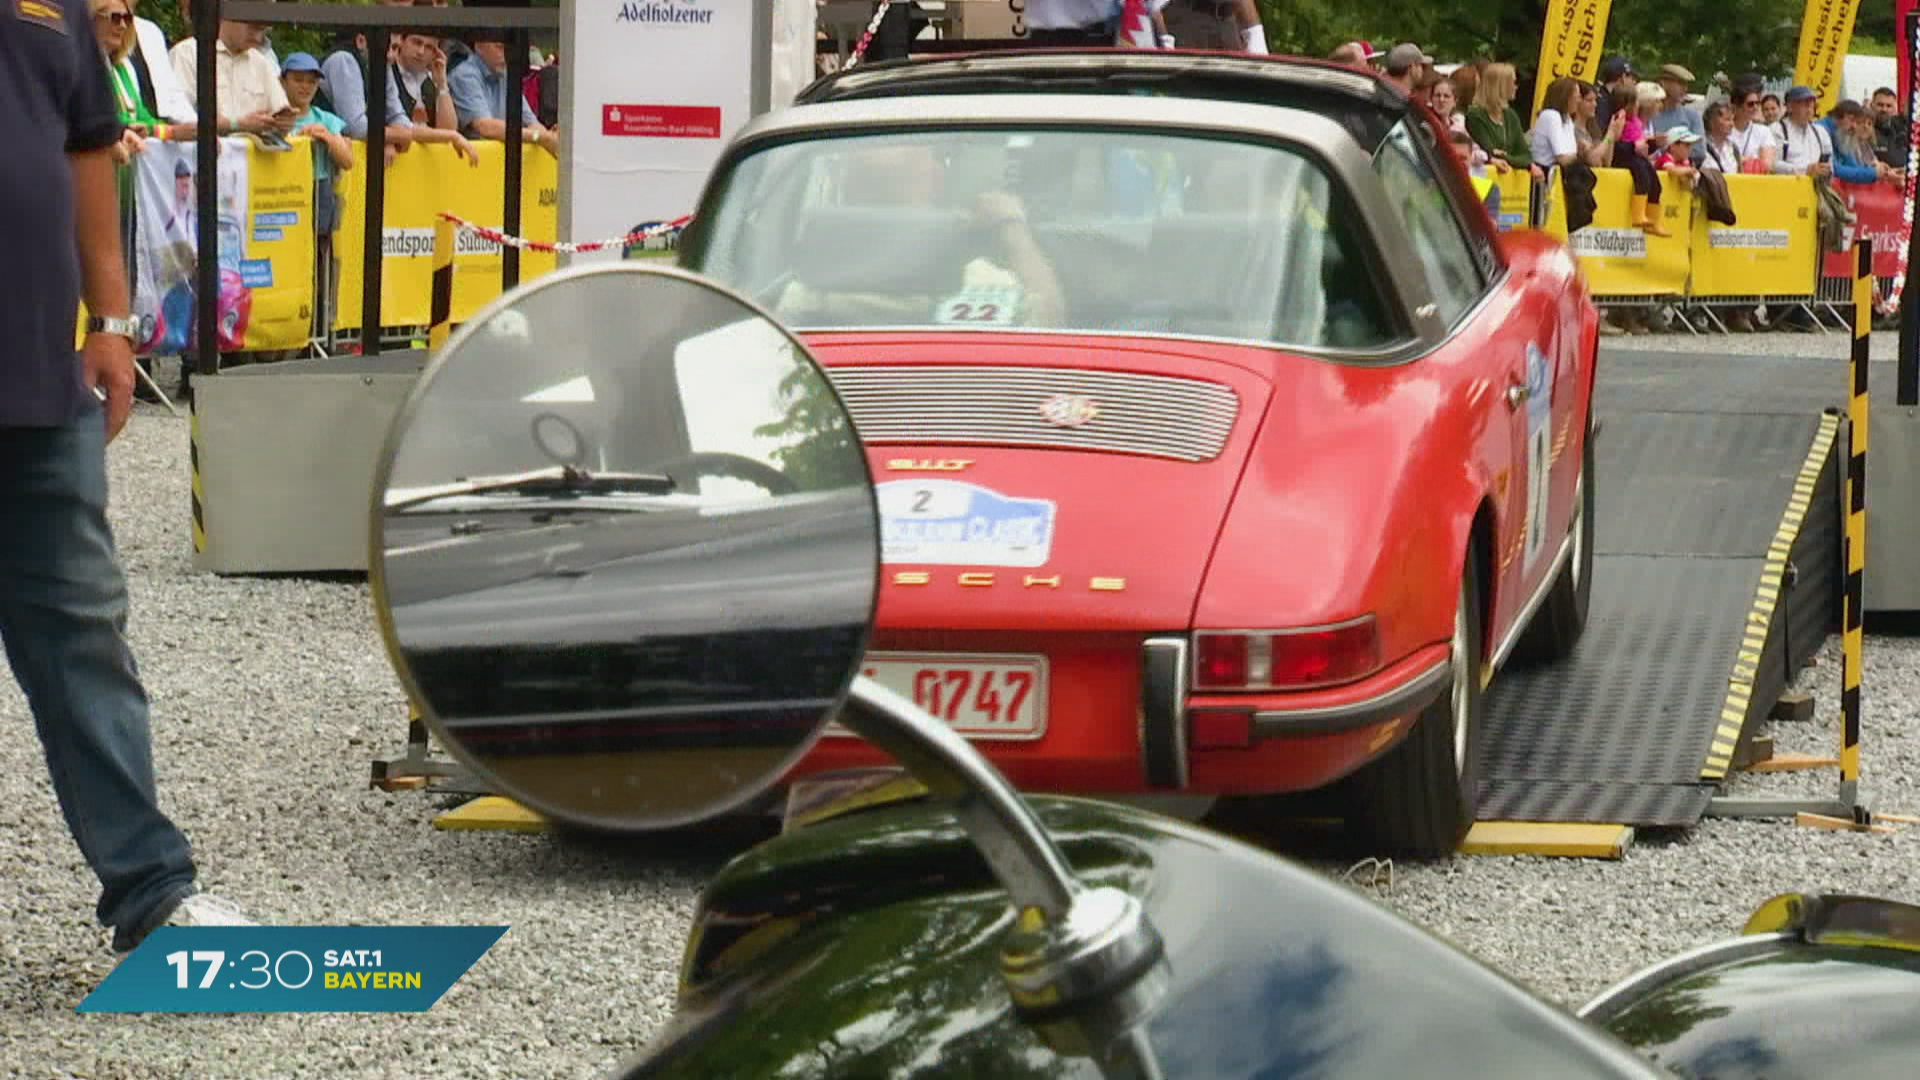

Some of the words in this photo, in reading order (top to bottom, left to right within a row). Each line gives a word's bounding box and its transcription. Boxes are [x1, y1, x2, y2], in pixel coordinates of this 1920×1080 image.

[616, 1, 714, 24] Adelholzener
[1570, 2, 1597, 78] ersich
[1594, 230, 1647, 256] Südbayern
[911, 490, 934, 512] 2
[914, 668, 1034, 722] 0747
